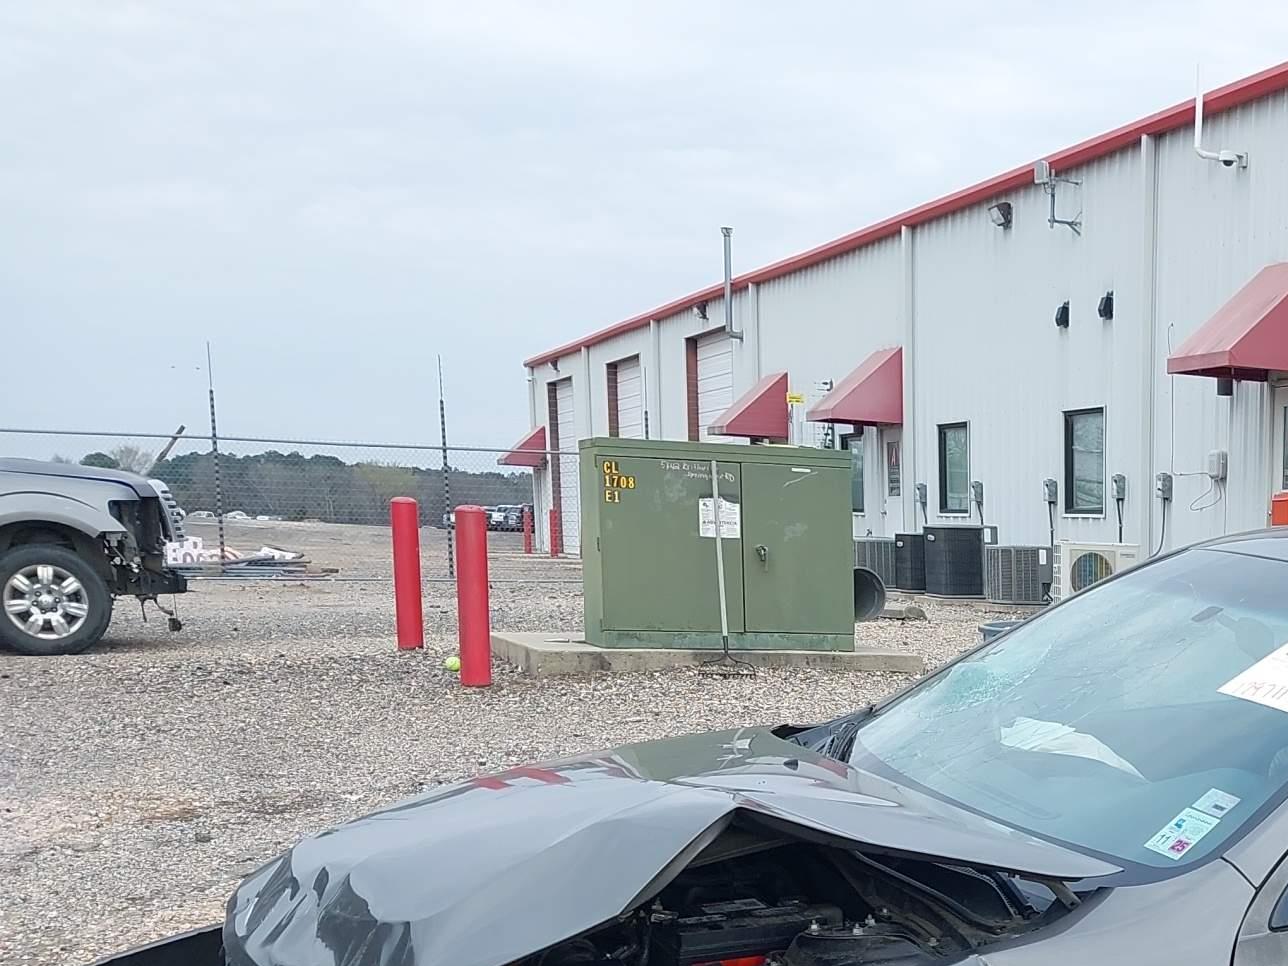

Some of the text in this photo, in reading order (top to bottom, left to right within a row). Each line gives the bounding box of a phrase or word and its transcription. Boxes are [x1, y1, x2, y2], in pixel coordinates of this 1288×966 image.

[603, 461, 619, 474] CL
[605, 475, 635, 489] 1708
[605, 490, 620, 503] E1
[1157, 834, 1171, 845] 11
[1170, 840, 1192, 852] 25
